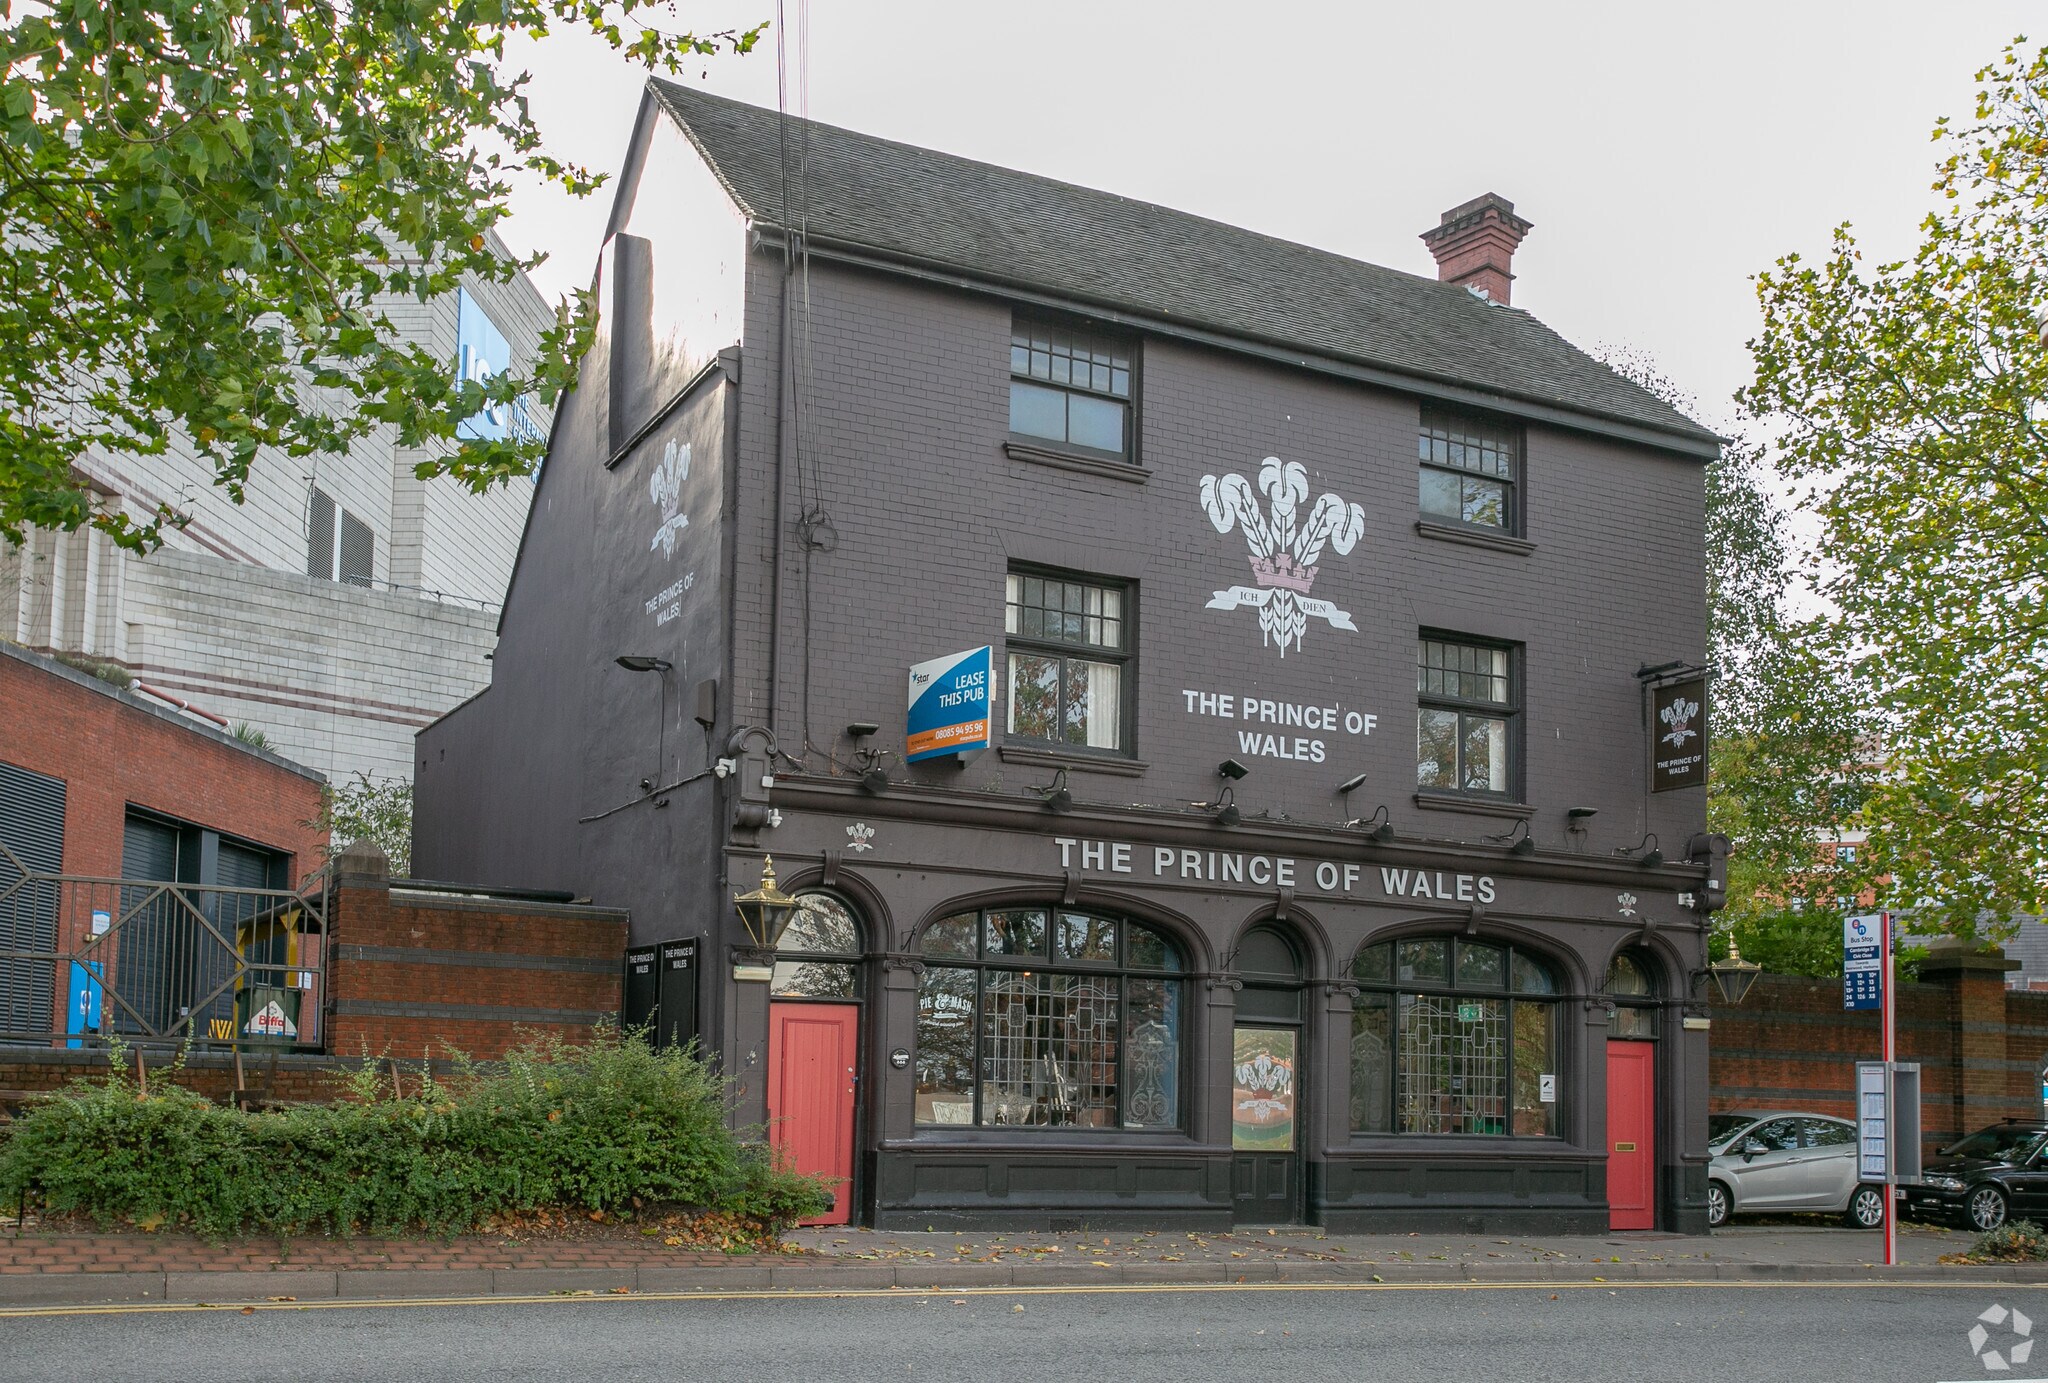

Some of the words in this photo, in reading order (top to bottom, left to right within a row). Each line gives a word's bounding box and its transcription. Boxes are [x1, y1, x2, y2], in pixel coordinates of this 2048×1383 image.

[645, 596, 657, 615] THE
[658, 579, 683, 606] PRINCE
[684, 572, 694, 590] OF
[1240, 591, 1258, 602] ICH
[1302, 601, 1326, 613] DIEN
[656, 601, 680, 627] WALES
[917, 673, 930, 684] star
[955, 671, 985, 690] LEASE
[939, 691, 962, 708] THIS
[964, 687, 985, 703] PUB
[1182, 689, 1234, 718] THE
[1243, 697, 1337, 731] PRINCE
[1345, 712, 1378, 735] OF
[935, 727, 955, 740] 08085
[955, 726, 964, 736] 94
[964, 724, 974, 734] 95
[974, 722, 984, 732] 96
[1238, 731, 1326, 763] WALES
[1657, 761, 1669, 769] THE
[1670, 757, 1692, 766] PRINCE
[1668, 766, 1689, 775] WALES
[1055, 837, 1132, 873] THE
[1154, 847, 1296, 887] PRINCE
[1316, 861, 1360, 891] OF
[1381, 867, 1496, 904] WALES
[629, 955, 637, 964] THE
[637, 953, 650, 963] PRINCE
[665, 949, 673, 958] THE
[673, 947, 688, 958] PRINCE
[636, 965, 649, 974] WALES
[673, 960, 688, 969] WALES
[920, 997, 932, 1009] PIE
[935, 993, 950, 1010] &
[951, 996, 972, 1013] MASH
[259, 1015, 285, 1027] Biffa
